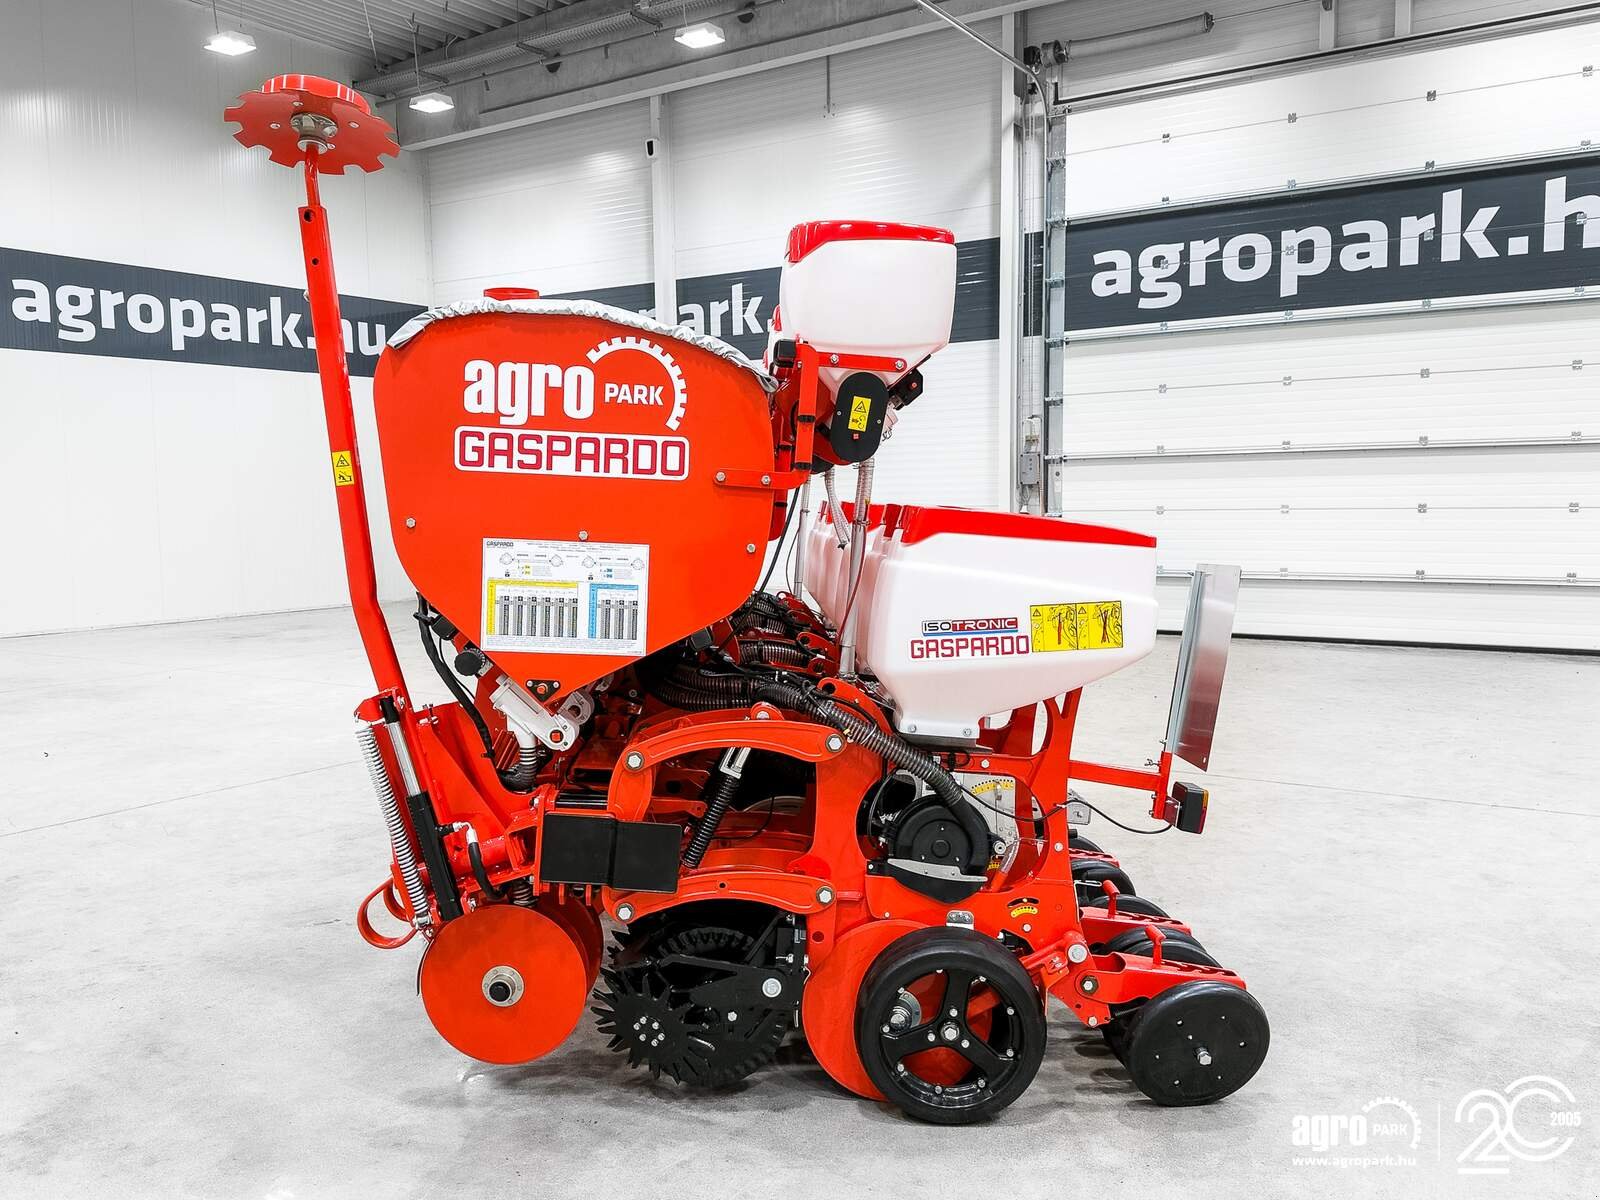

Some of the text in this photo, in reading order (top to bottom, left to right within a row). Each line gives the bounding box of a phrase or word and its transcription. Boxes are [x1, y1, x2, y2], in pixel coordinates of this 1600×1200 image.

[463, 359, 664, 426] agro PARK
[458, 430, 686, 477] GASPARDO
[923, 617, 1018, 632] ISOTRONIC
[910, 635, 1030, 659] GASPARDO
